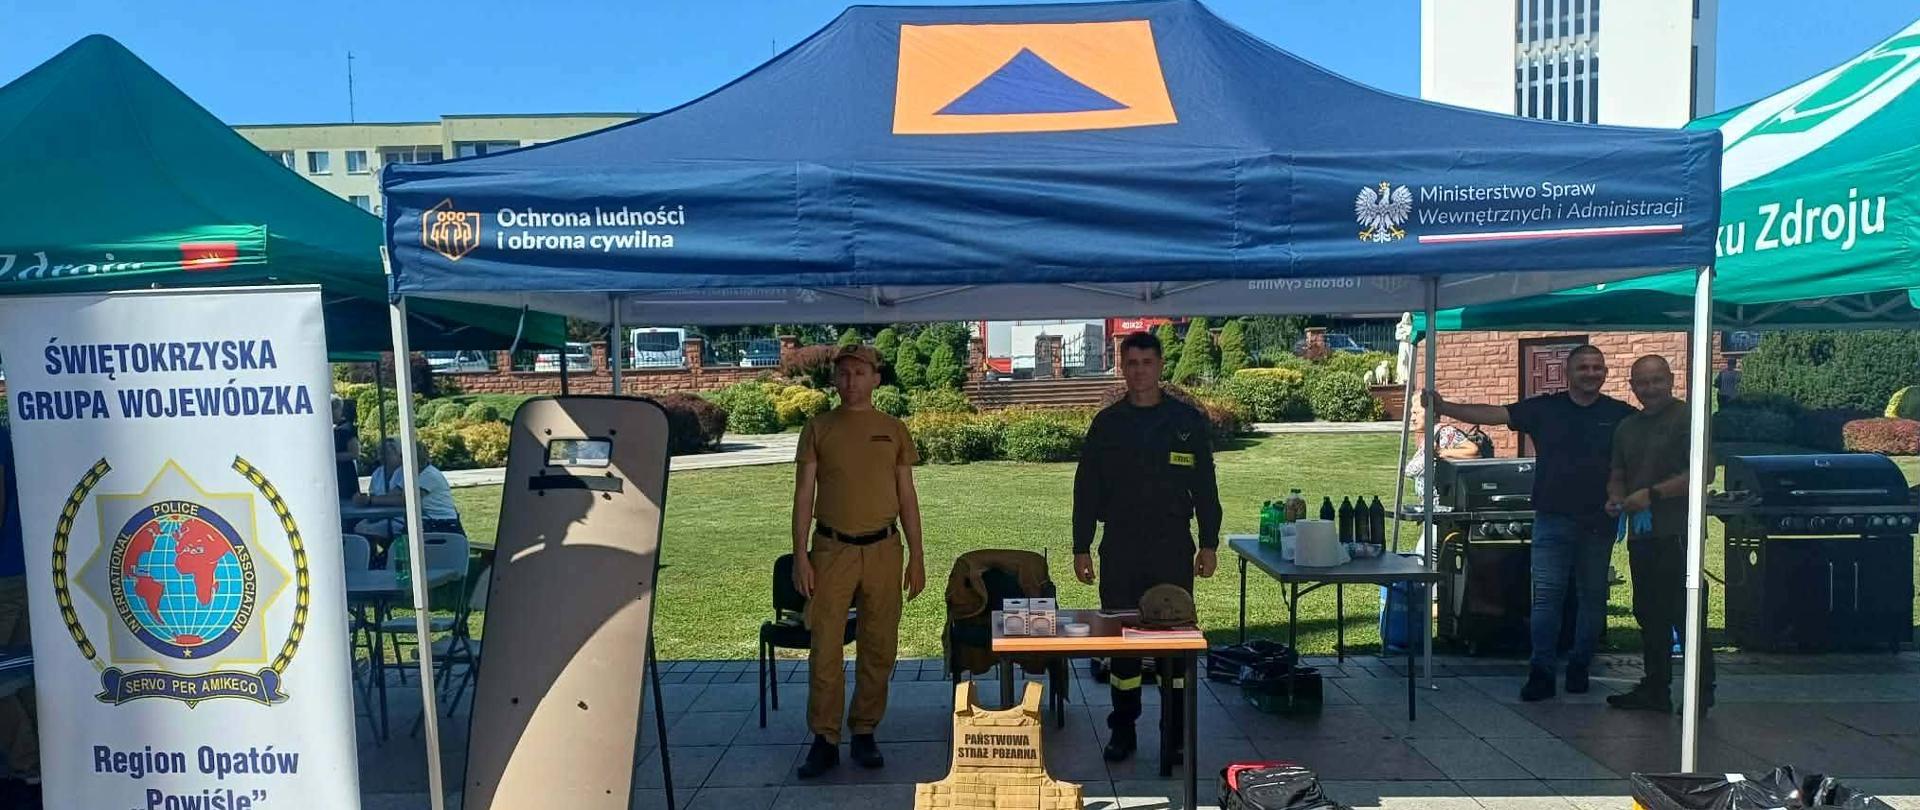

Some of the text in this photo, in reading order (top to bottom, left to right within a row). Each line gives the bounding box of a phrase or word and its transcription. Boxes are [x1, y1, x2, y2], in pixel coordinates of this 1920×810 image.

[1420, 181, 1596, 203] Ministerstwo Spraw
[497, 205, 685, 228] Ochrona ludności
[1418, 198, 1684, 226] Wewnętrznych i Administracji
[1755, 187, 1886, 251] Zdroju
[497, 230, 674, 252] i obrona cywilna
[45, 337, 277, 380] ŚWIĘTOKRZYSKA
[17, 379, 313, 420] GRUPA WOJEWÓDZKA
[110, 503, 255, 634] INTERNATIONAL POLICE ASSOCIATION
[125, 676, 258, 695] SERVO PER AMIKECO
[964, 732, 1030, 746] PAŃSTWOWA
[93, 745, 299, 780] Region Opatów
